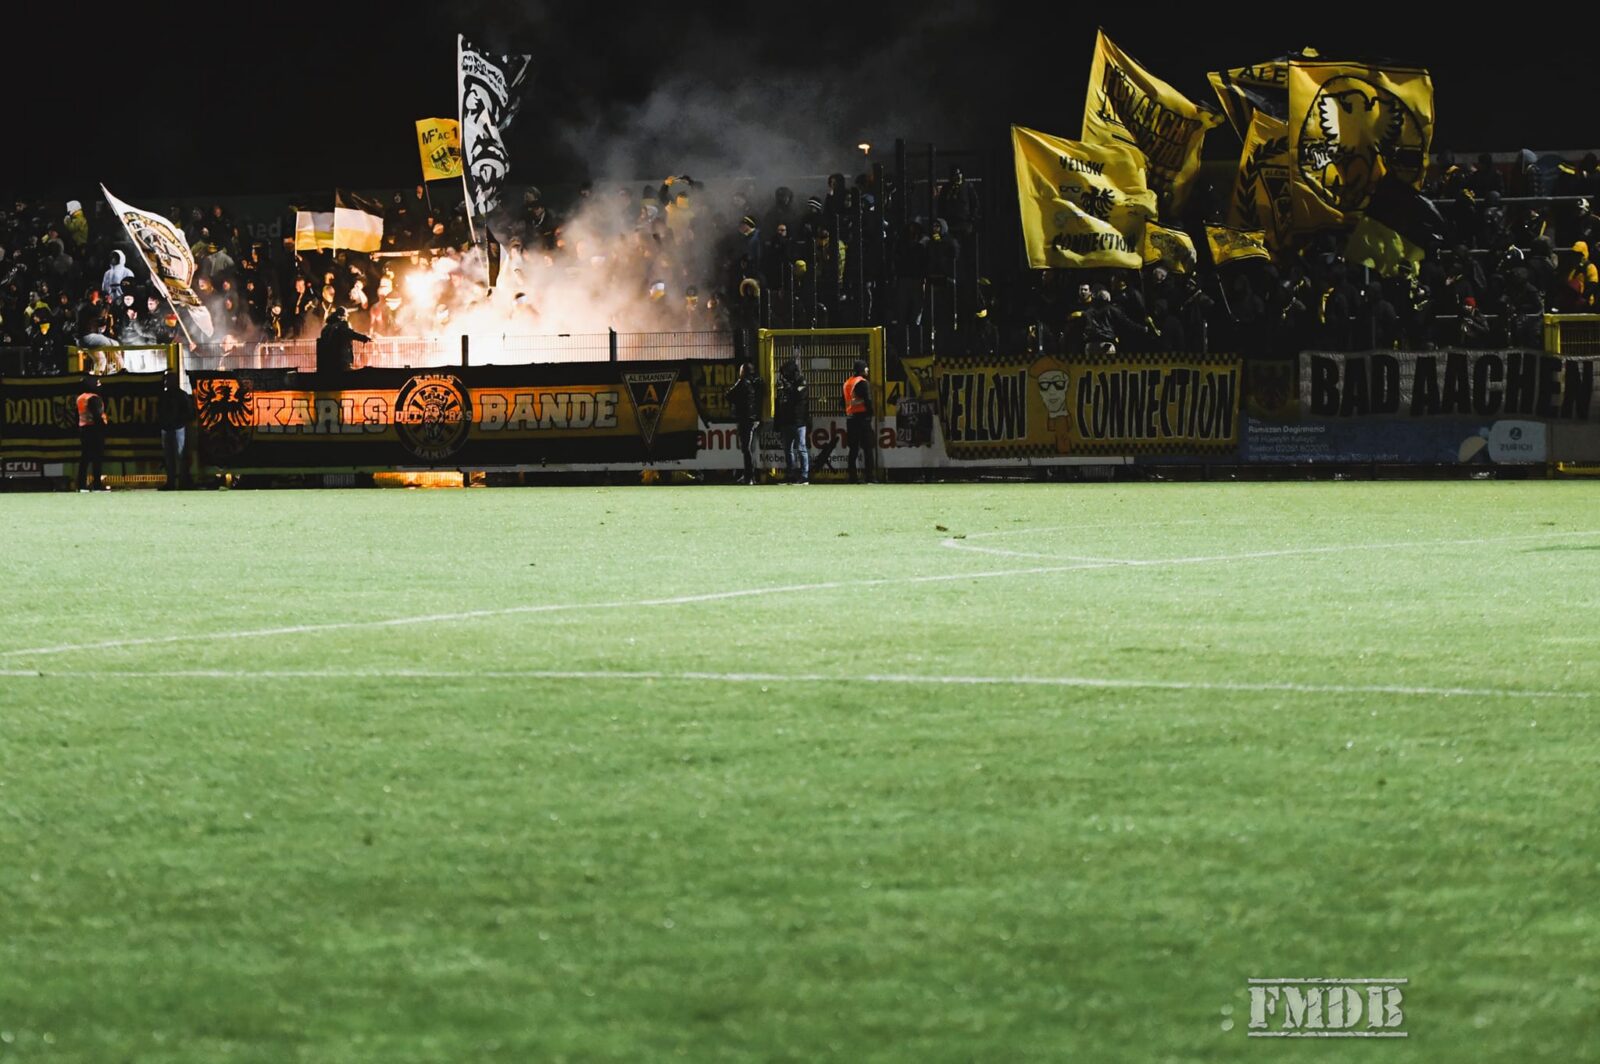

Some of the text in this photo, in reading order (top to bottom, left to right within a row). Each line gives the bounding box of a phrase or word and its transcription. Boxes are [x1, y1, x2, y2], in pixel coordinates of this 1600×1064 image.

[1059, 155, 1105, 176] YELLOW
[1053, 231, 1138, 254] CONNECTION
[629, 373, 673, 382] ALEMANNIA
[1309, 352, 1594, 419] BAD AACHEN
[257, 391, 619, 435] KARLS BANDE
[939, 368, 1238, 442] YELLOW CONNECTION
